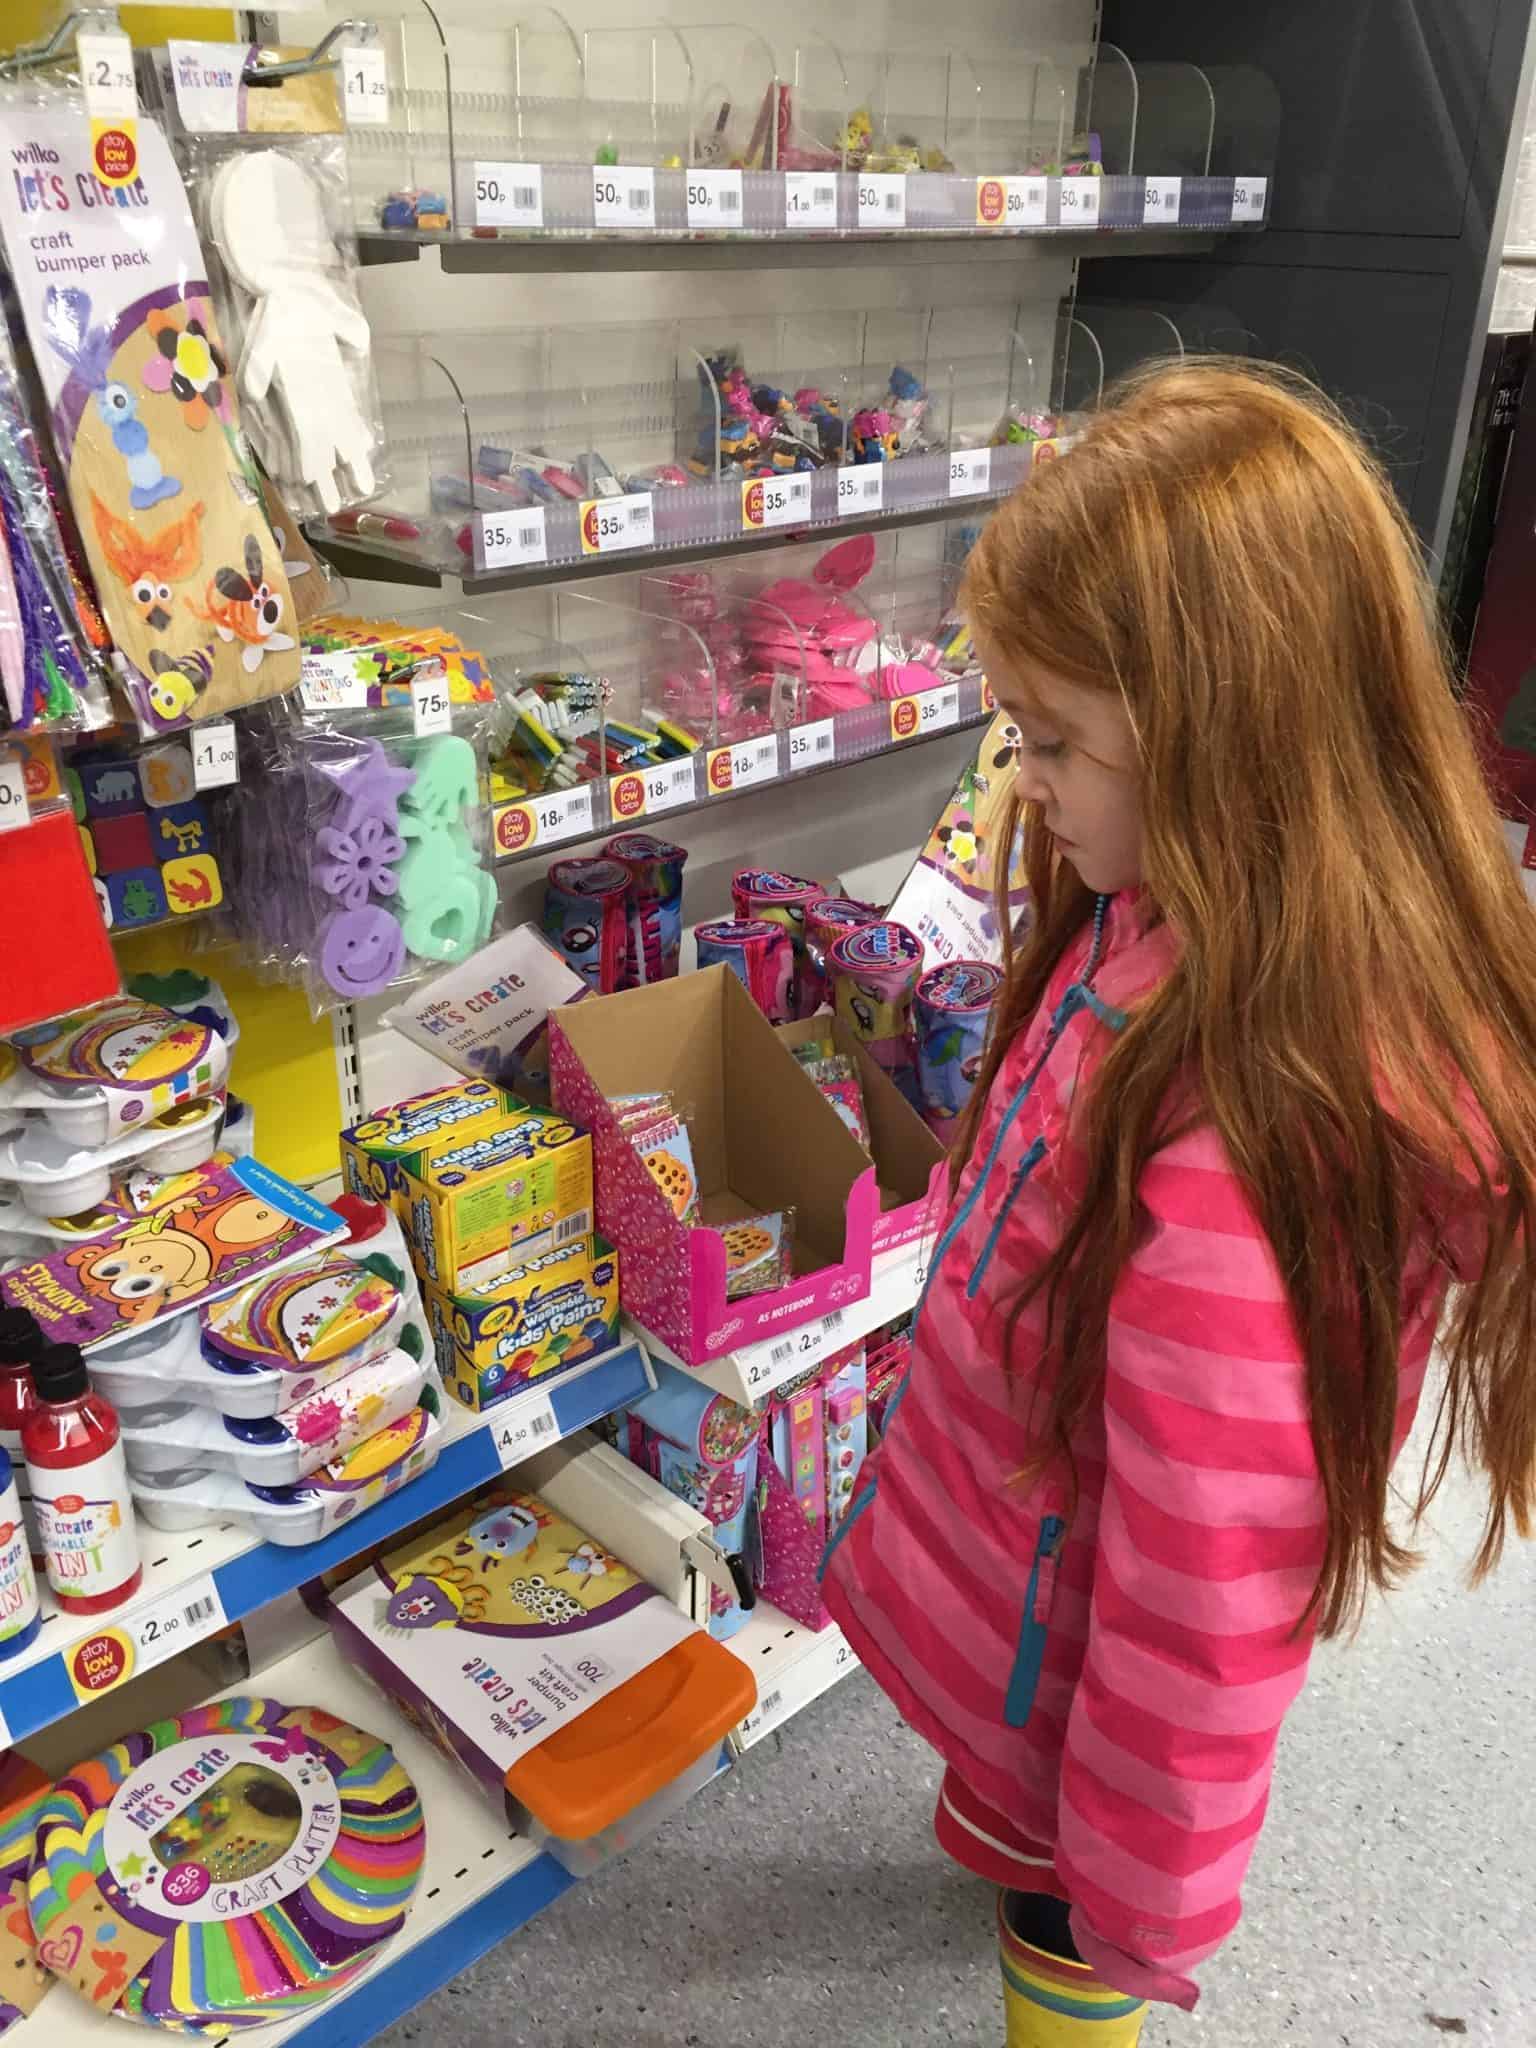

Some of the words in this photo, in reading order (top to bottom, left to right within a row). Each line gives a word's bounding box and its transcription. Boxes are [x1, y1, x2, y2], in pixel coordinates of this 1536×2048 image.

[88, 61, 134, 87] £2.75
[348, 71, 386, 95] £1.25
[11, 142, 60, 165] wilko
[104, 149, 128, 161] low
[12, 168, 70, 213] let's
[476, 180, 506, 204] 50p
[595, 183, 622, 204] 50p
[688, 186, 713, 207] 50p
[30, 231, 74, 251] craft
[35, 253, 107, 274] bumper
[112, 249, 152, 271] pack
[484, 527, 512, 547] 35p
[197, 745, 235, 766] £1.00
[620, 790, 639, 803] low
[503, 812, 523, 826] stay
[503, 824, 525, 837] low
[416, 1000, 451, 1021] wilko
[420, 1009, 466, 1036] let's
[465, 973, 526, 1014] create
[447, 1028, 477, 1046] craft
[453, 1024, 504, 1052] bumper
[503, 1007, 536, 1029] pack
[438, 1098, 498, 1125] Paint
[526, 1242, 586, 1272] Paint
[21, 1263, 94, 1315] ANIMALS
[524, 1292, 587, 1328] Washable
[771, 1293, 816, 1321] NOTEBOOK
[497, 1321, 548, 1360] Kids'
[549, 1298, 607, 1335] Paint
[488, 1366, 499, 1380] 6
[55, 1519, 94, 1535] create
[140, 1618, 179, 1646] £2.00
[80, 1639, 109, 1661] stay
[83, 1651, 114, 1676] low
[89, 1663, 119, 1688] price
[538, 1667, 555, 1684] kit
[576, 1659, 606, 1684] 700
[461, 1657, 514, 1703] create
[552, 1681, 580, 1702] craft
[527, 1676, 568, 1712] bumper
[490, 1711, 519, 1740] wilko
[507, 1699, 547, 1734] let's
[120, 1782, 155, 1812] wilko
[125, 1794, 177, 1832] let's
[169, 1747, 231, 1797] create
[210, 1871, 285, 1914] CRAFT
[283, 1802, 336, 1877] PLATTER
[166, 1865, 201, 1897] 836
